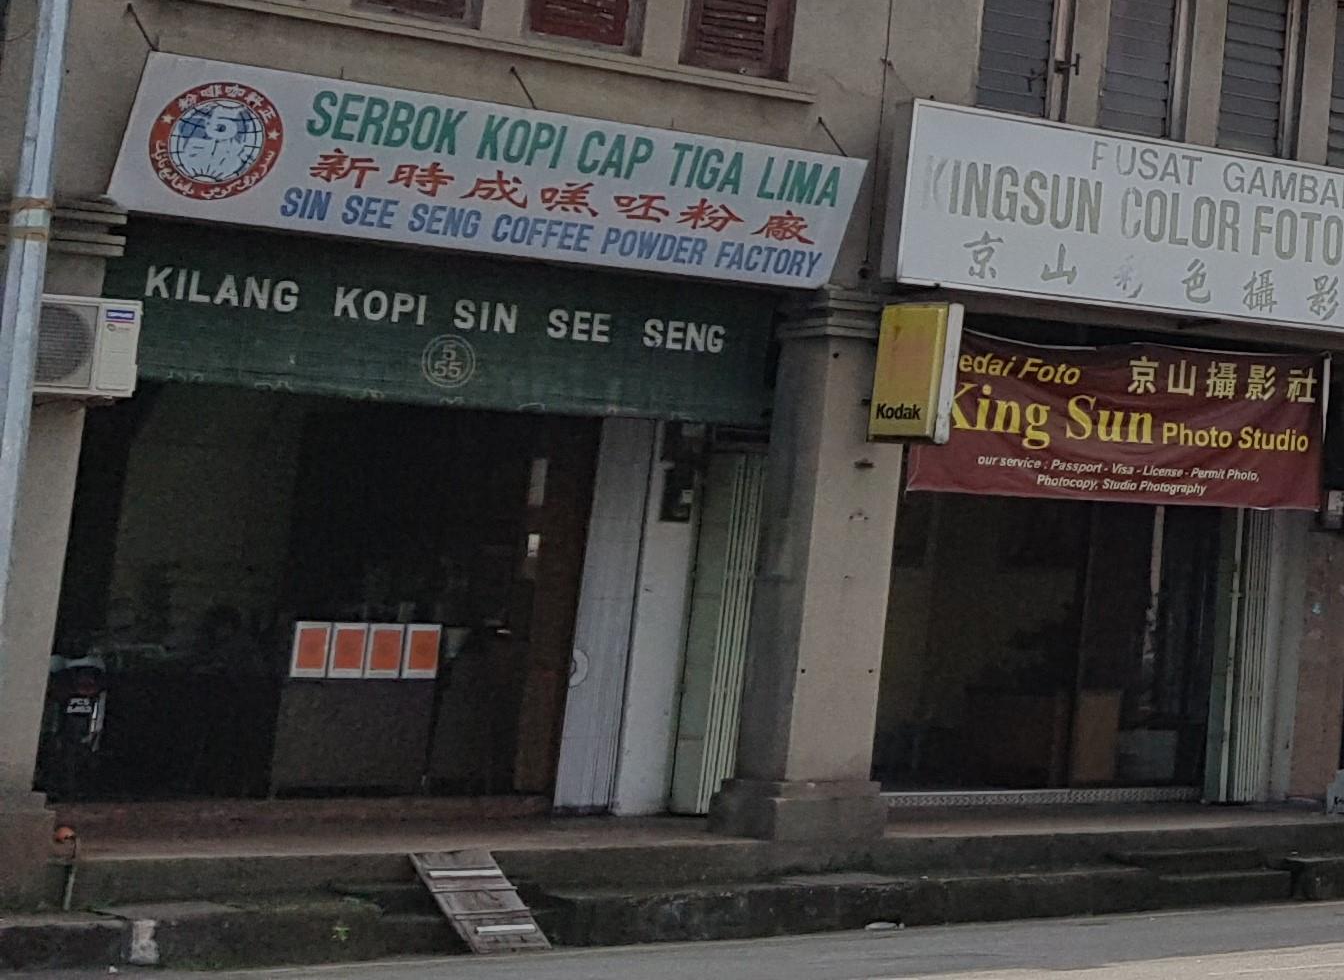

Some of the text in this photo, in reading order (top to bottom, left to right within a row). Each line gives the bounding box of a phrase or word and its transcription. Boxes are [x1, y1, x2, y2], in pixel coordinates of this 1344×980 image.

[306, 91, 841, 208] SERBOK KOPI CAP TIGA LIMA
[280, 186, 822, 278] SIN SEE SENG COFFEE POWDER FACTORY
[1121, 187, 1240, 252] COLOR
[1252, 205, 1343, 266] FOTO
[145, 265, 725, 354] KILANG KOPI SIN SEE SENG
[959, 353, 1081, 385] edai Foto
[1127, 356, 1318, 403] 京山攝影社
[876, 403, 921, 421] Kodak
[951, 382, 1154, 450] King Sun
[1163, 422, 1309, 452] Photo Studio
[978, 455, 997, 467] our
[999, 456, 1041, 469] service
[1051, 459, 1102, 475] Passport
[1111, 463, 1133, 475] Visa
[1143, 464, 1183, 478] License
[1190, 467, 1226, 481] Permit
[1102, 479, 1137, 491] Studio
[1139, 480, 1207, 496] Photography
